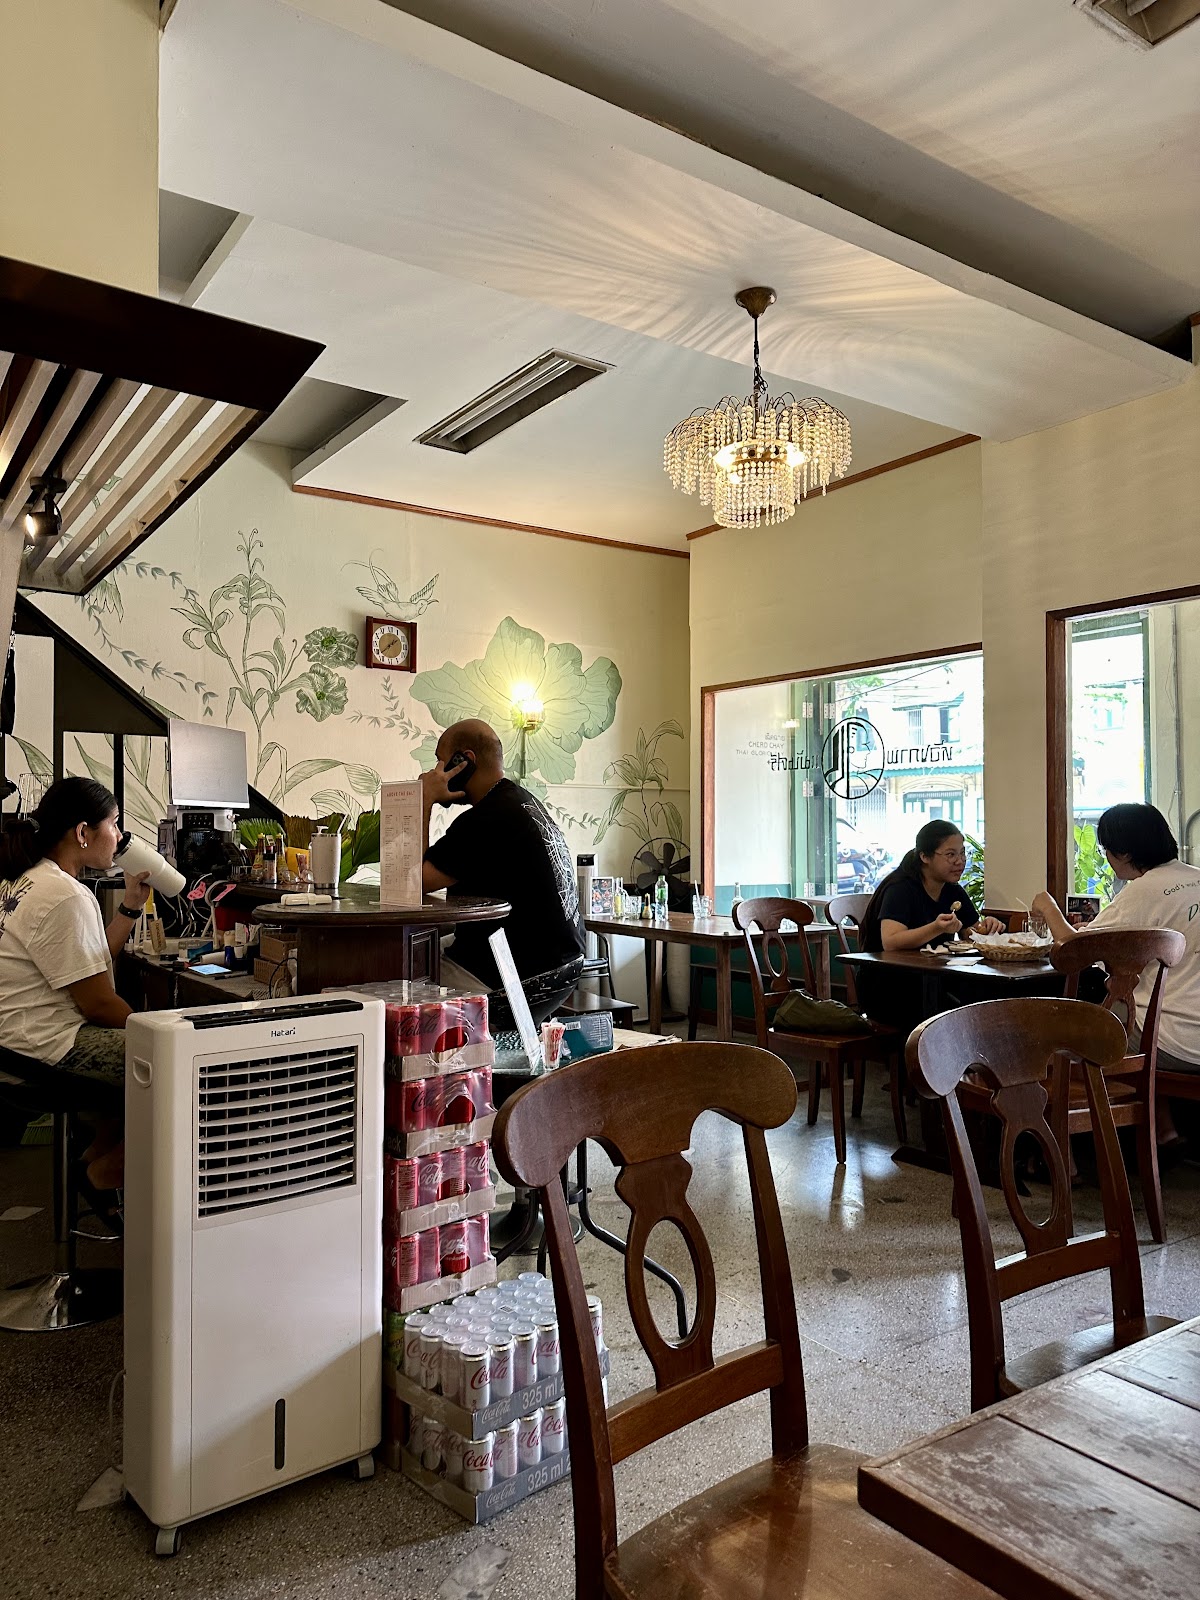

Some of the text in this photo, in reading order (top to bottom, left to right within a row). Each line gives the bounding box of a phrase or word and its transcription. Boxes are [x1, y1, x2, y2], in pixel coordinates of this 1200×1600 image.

[748, 741, 768, 749] CHERD
[1163, 883, 1185, 896] God's
[1188, 903, 1200, 921] D
[271, 1027, 296, 1037] Hatari
[522, 1385, 542, 1410] 325
[545, 1378, 558, 1398] ml
[527, 1466, 548, 1492] 325
[550, 1460, 564, 1478] ml
